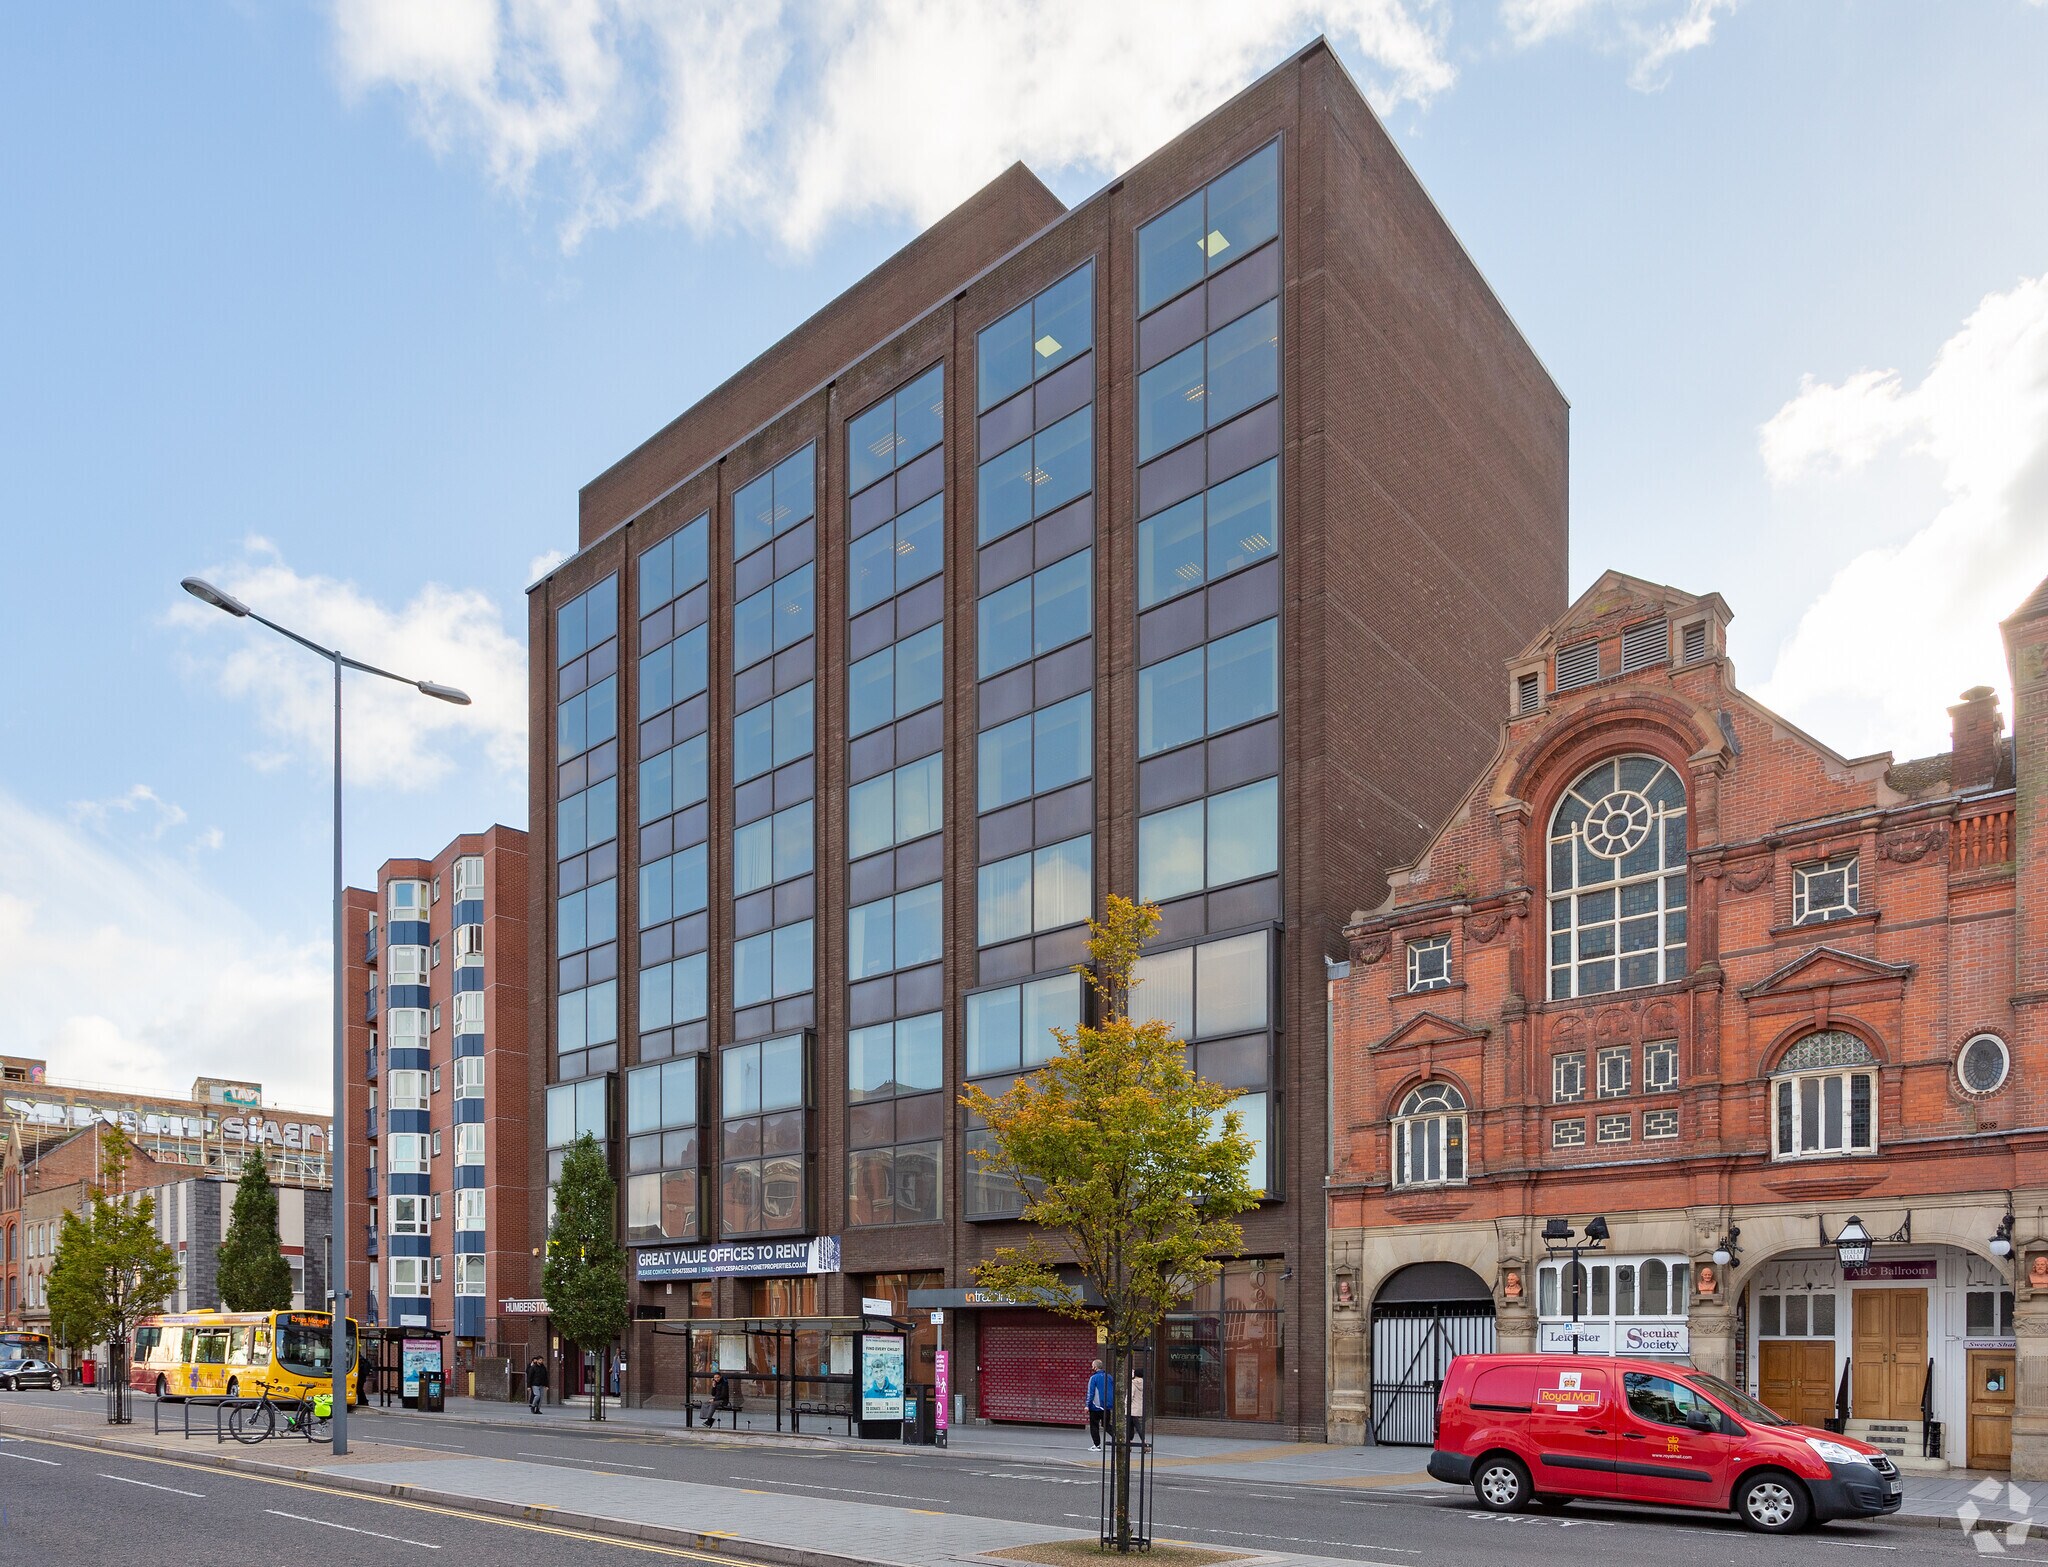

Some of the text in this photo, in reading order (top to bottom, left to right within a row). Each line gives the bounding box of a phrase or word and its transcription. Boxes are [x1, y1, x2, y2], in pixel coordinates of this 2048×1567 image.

[638, 1243, 807, 1266] GREAT VALUE OFFICES TO RENT
[1851, 1266, 1929, 1276] ABC Ballroom
[1550, 1332, 1600, 1342] Leicster
[1542, 1391, 1595, 1402] Royal Mail
[1467, 1513, 1584, 1527] ONLY
